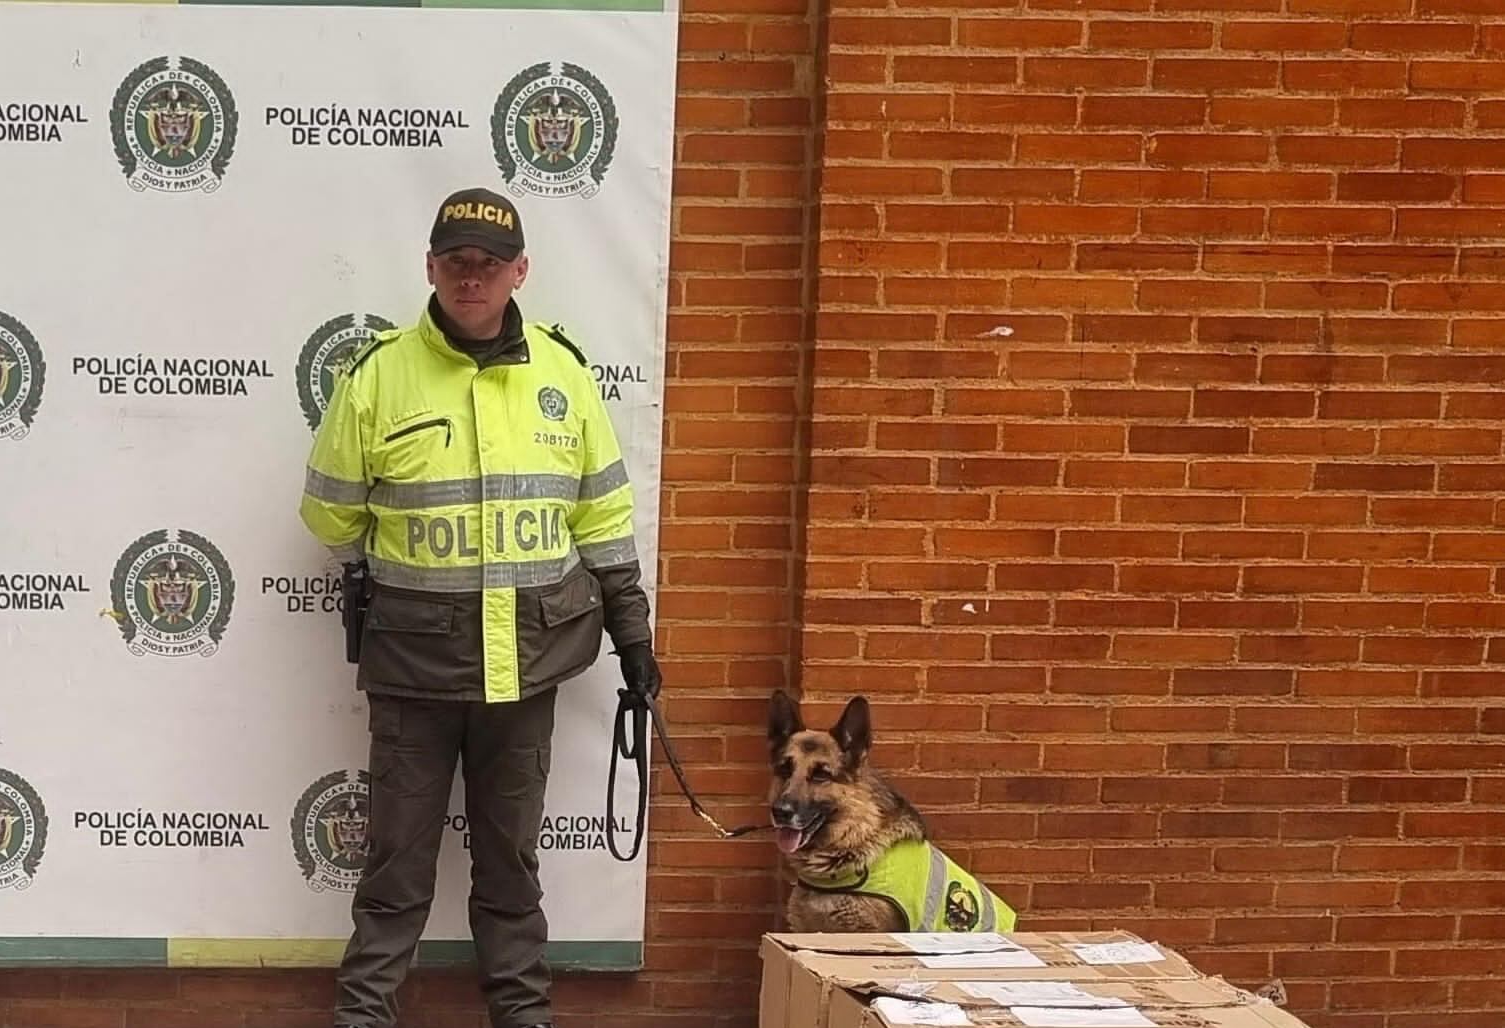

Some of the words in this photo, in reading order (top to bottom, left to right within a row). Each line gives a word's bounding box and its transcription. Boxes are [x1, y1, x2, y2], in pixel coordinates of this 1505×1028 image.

[169, 72, 183, 80] DE
[193, 79, 222, 133] COLOMBIA
[266, 104, 349, 126] POLICÍA
[358, 109, 469, 127] NACIONAL
[551, 78, 564, 86] DE
[574, 84, 602, 139] COLOMBIA
[292, 128, 321, 145] DE
[327, 128, 443, 147] COLOMBIA
[174, 145, 218, 175] NACIONAL
[553, 151, 597, 181] NACIONAL
[444, 204, 514, 231] POLICIA
[0, 330, 30, 383] COLOMBIA
[73, 354, 155, 375] POLICÍA
[163, 359, 274, 377] NACIONAL
[99, 378, 127, 394] DE
[134, 378, 248, 396] COLOMBIA
[407, 508, 561, 558] POLICIA
[167, 544, 181, 552] DE
[190, 550, 219, 601] COLOMBIA
[287, 596, 315, 612] DE
[173, 612, 215, 641] NACIONAL
[4, 786, 32, 836] COLOMBIA
[74, 808, 157, 828] POLICÍA
[163, 813, 270, 830] NACIONAL
[541, 816, 632, 832] ACIONAL
[100, 830, 127, 846] DE
[133, 830, 245, 847] COLOMBIA
